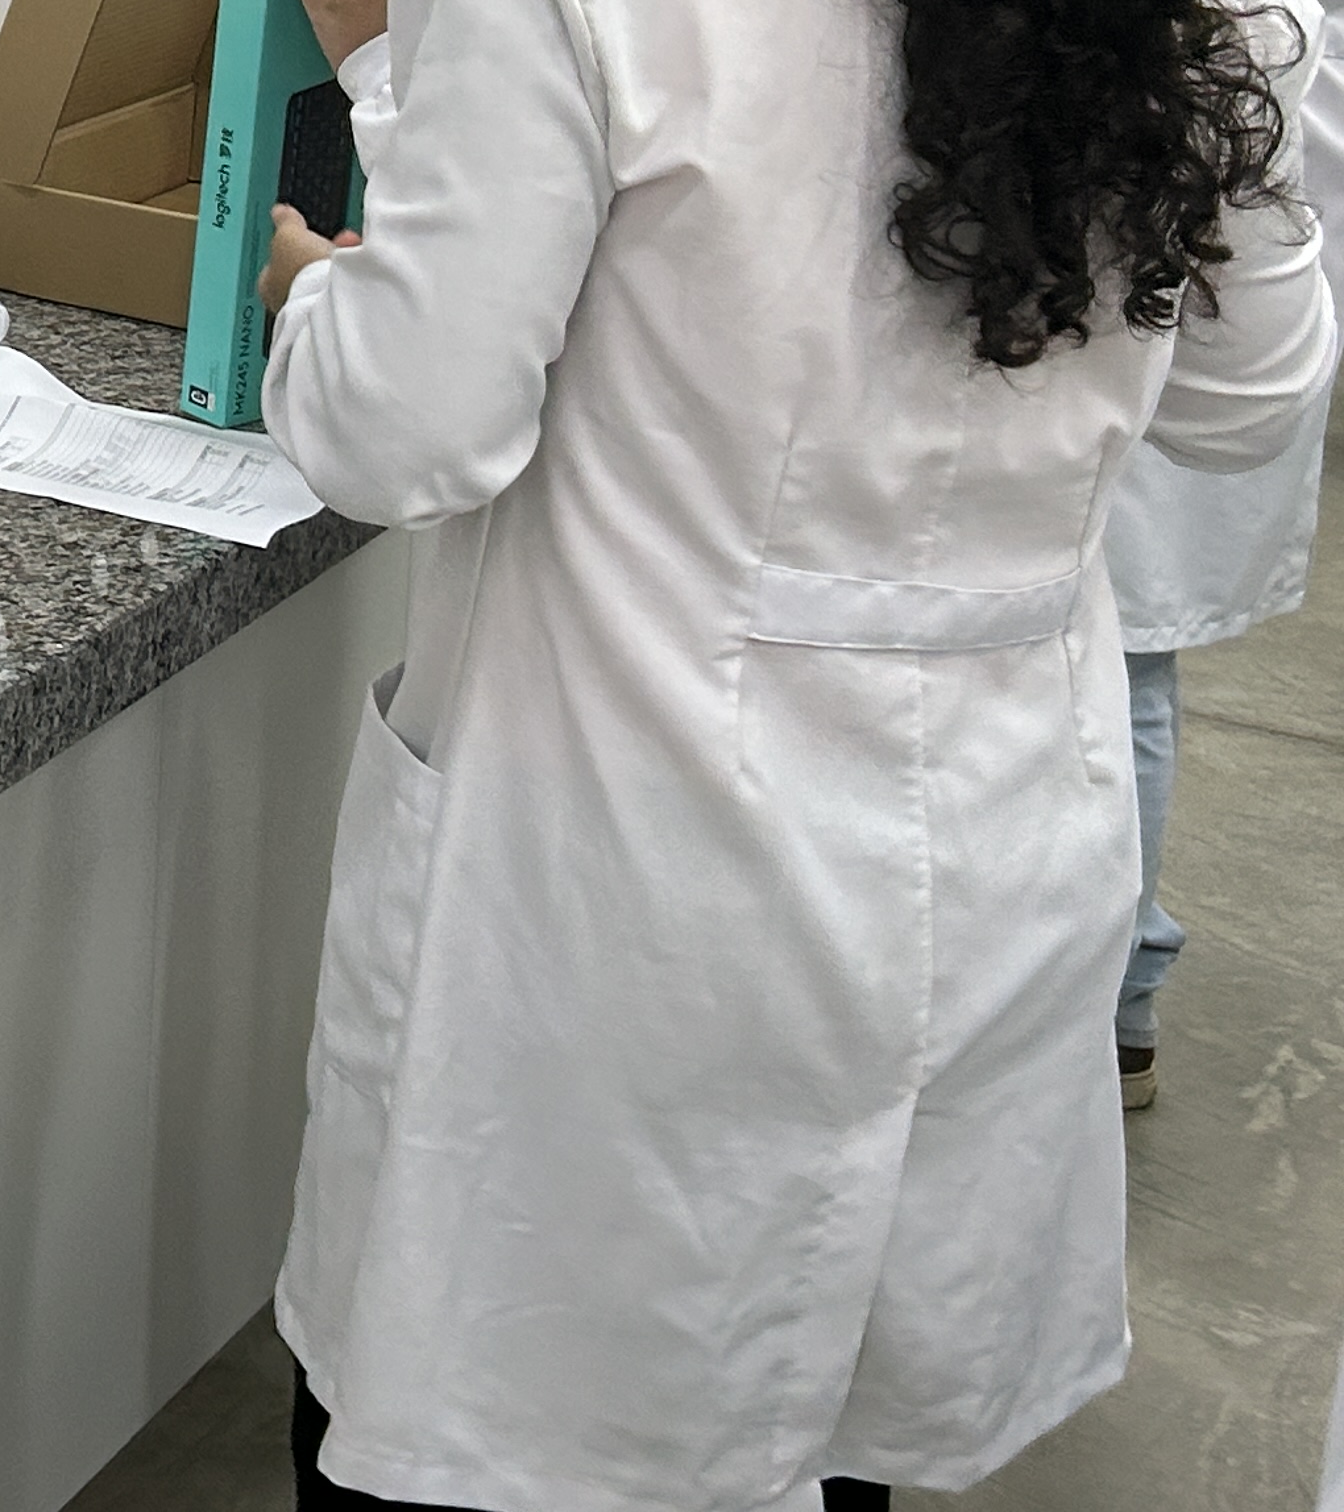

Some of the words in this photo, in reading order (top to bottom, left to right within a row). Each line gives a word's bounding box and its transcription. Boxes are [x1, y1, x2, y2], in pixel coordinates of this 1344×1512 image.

[212, 163, 231, 229] logitech
[238, 304, 255, 358] NANO
[233, 361, 250, 416] MK245
